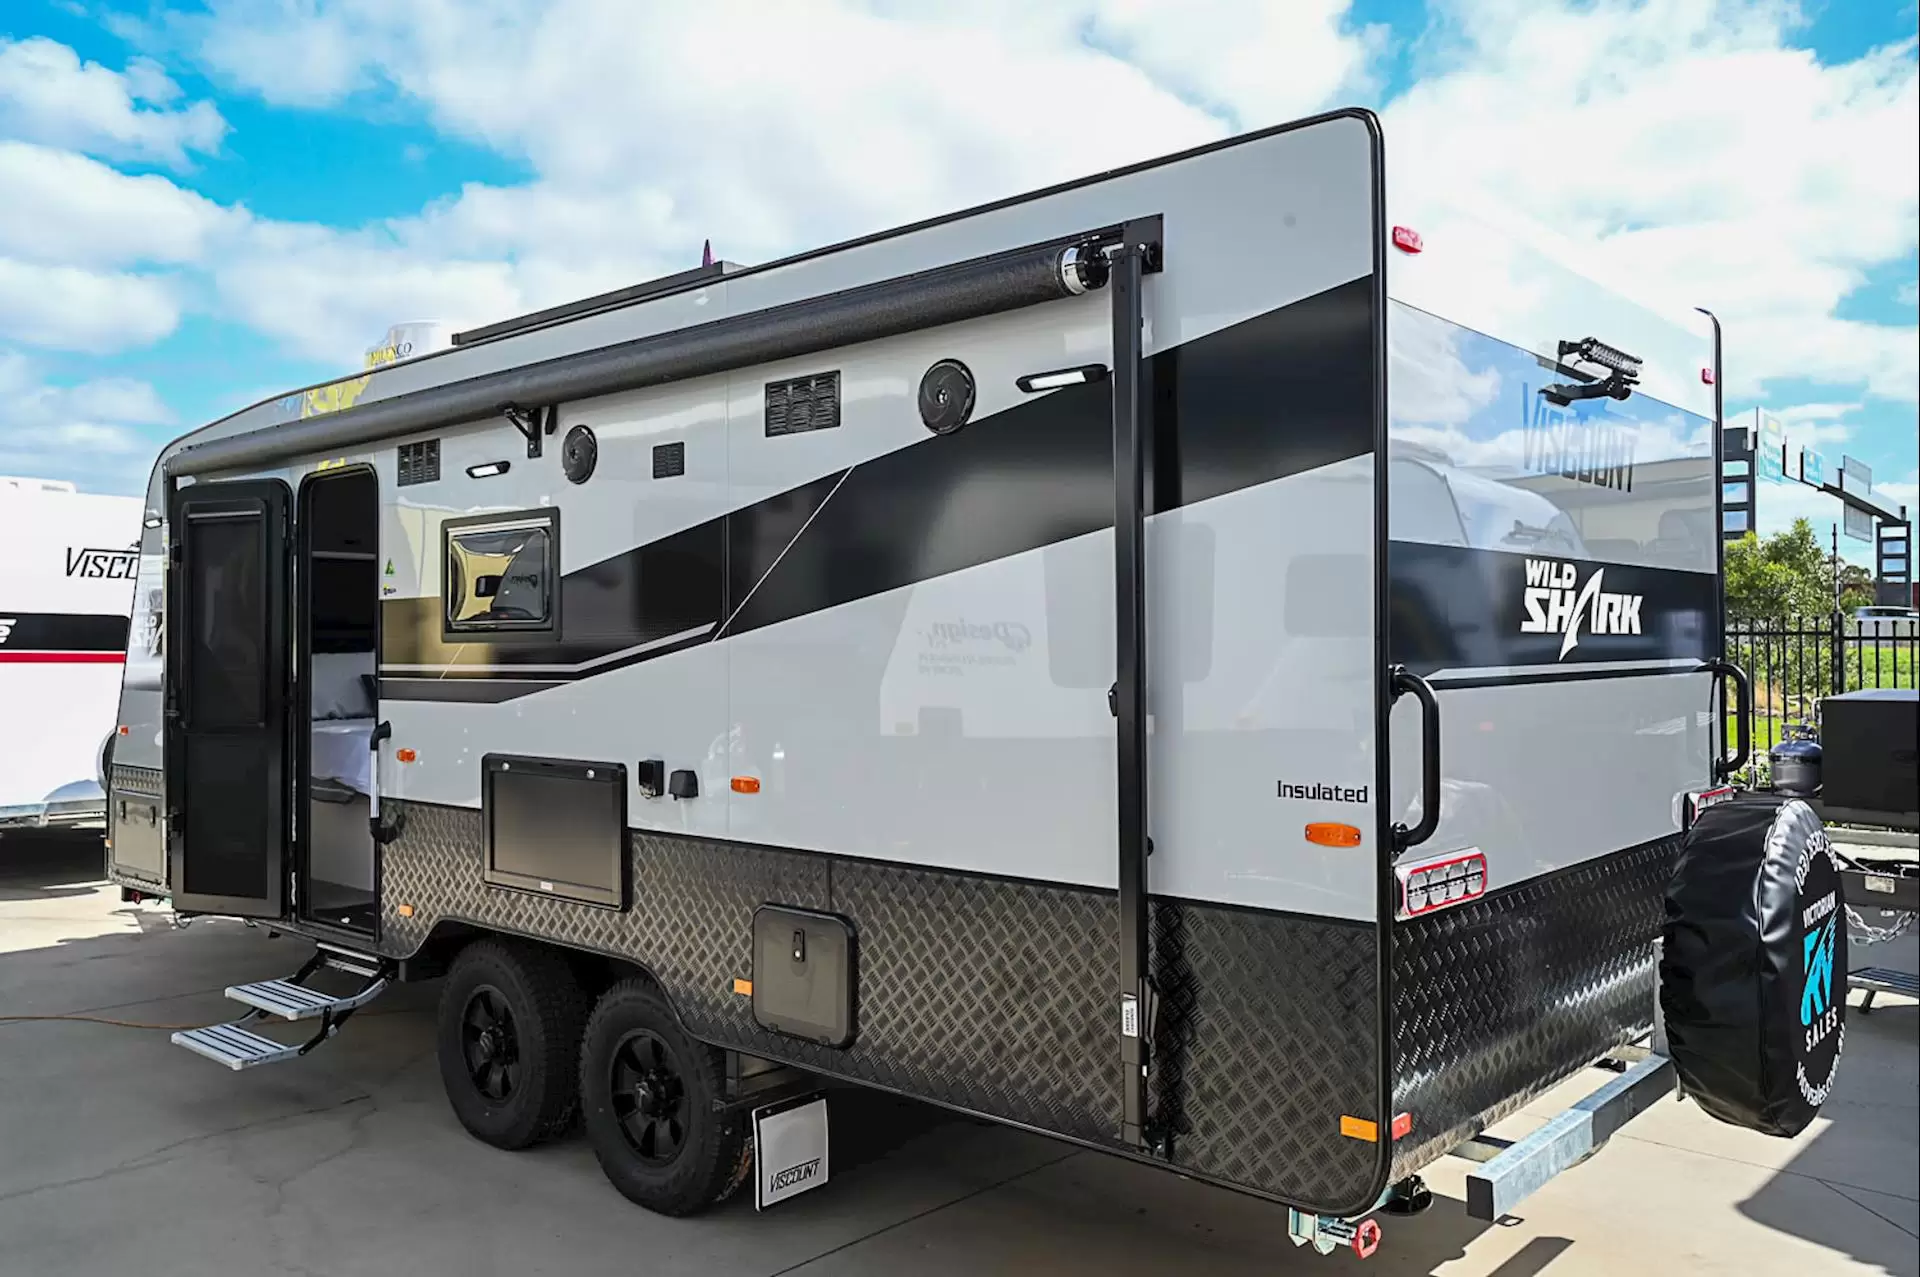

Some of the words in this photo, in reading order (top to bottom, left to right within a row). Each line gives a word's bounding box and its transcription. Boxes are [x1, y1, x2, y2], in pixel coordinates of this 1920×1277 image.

[1522, 382, 1638, 493] VISCOUNT
[1525, 558, 1577, 589] WILD
[1520, 567, 1643, 662] SHARK
[1277, 780, 1368, 803] Insulated
[1802, 890, 1836, 929] VICTORIAN
[1805, 1006, 1838, 1053] SALES
[769, 1157, 821, 1193] VISCOUNT
